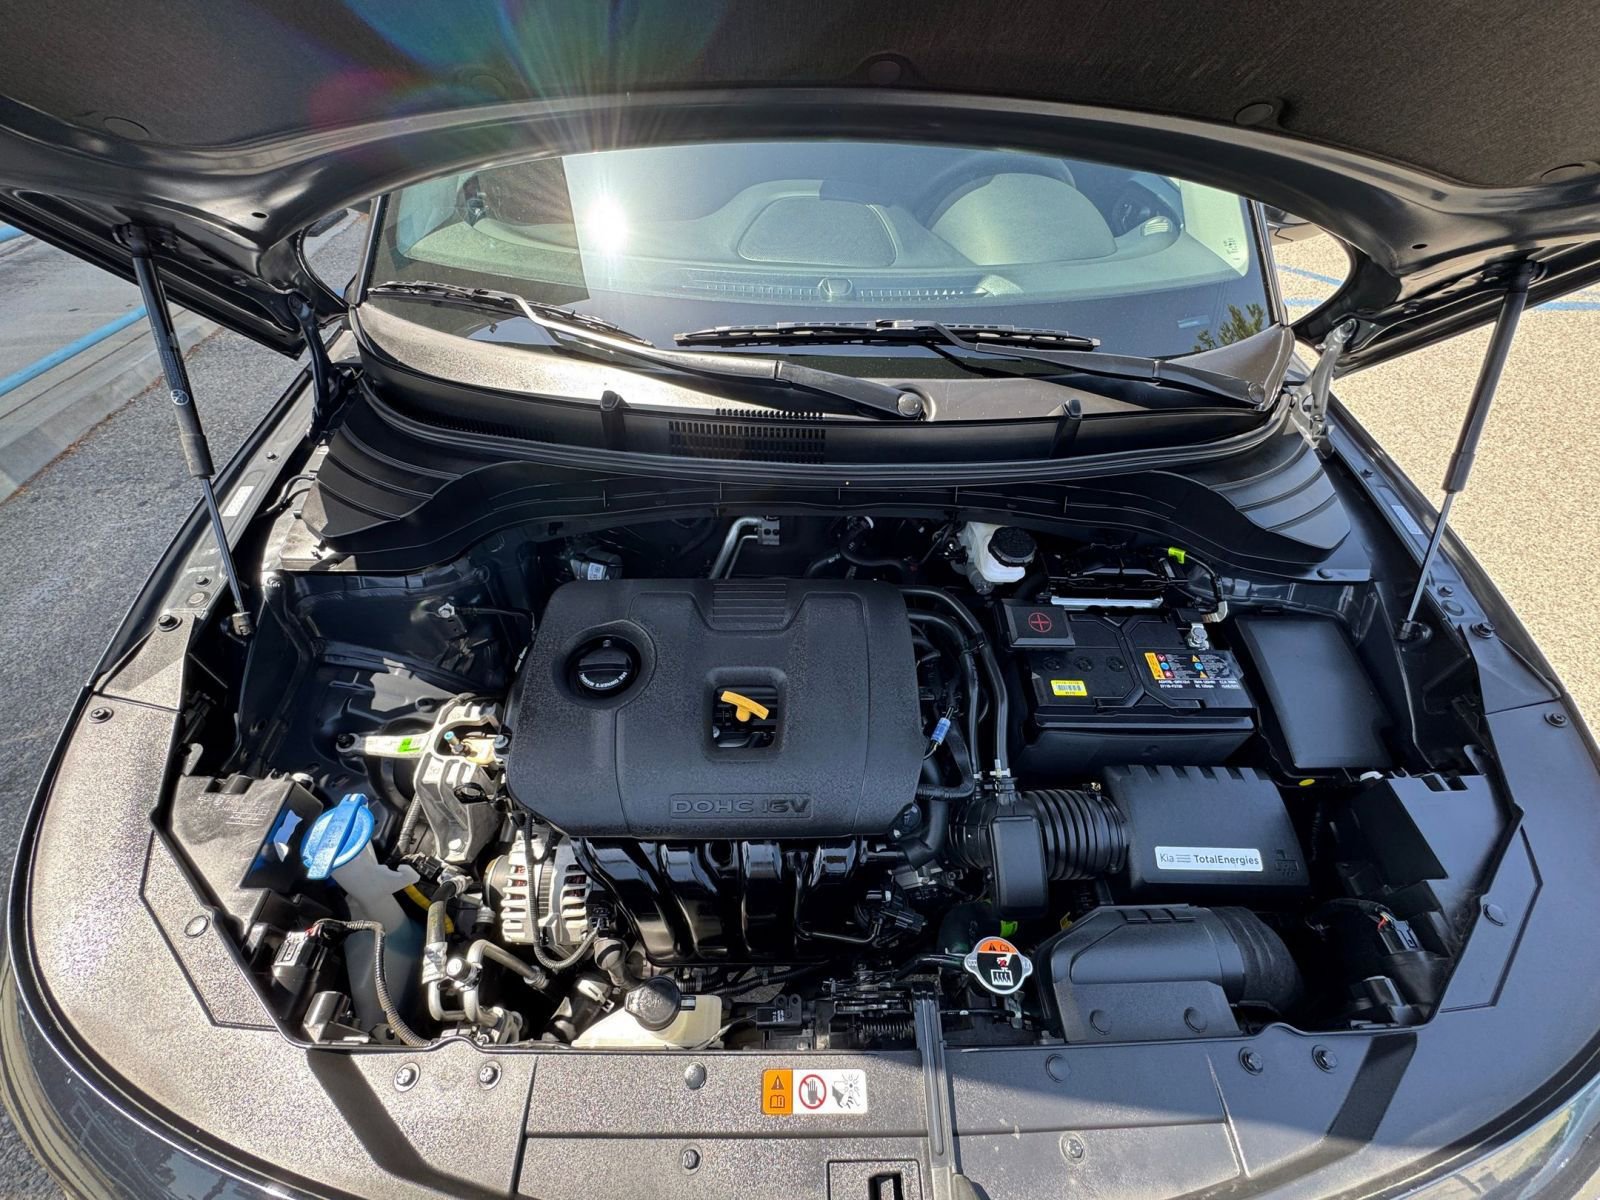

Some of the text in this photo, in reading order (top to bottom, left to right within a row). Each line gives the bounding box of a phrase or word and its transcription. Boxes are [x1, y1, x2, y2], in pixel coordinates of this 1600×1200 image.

[672, 799, 810, 813] DOHC 16V
[1160, 853, 1259, 866] Kia TotalEnergies
